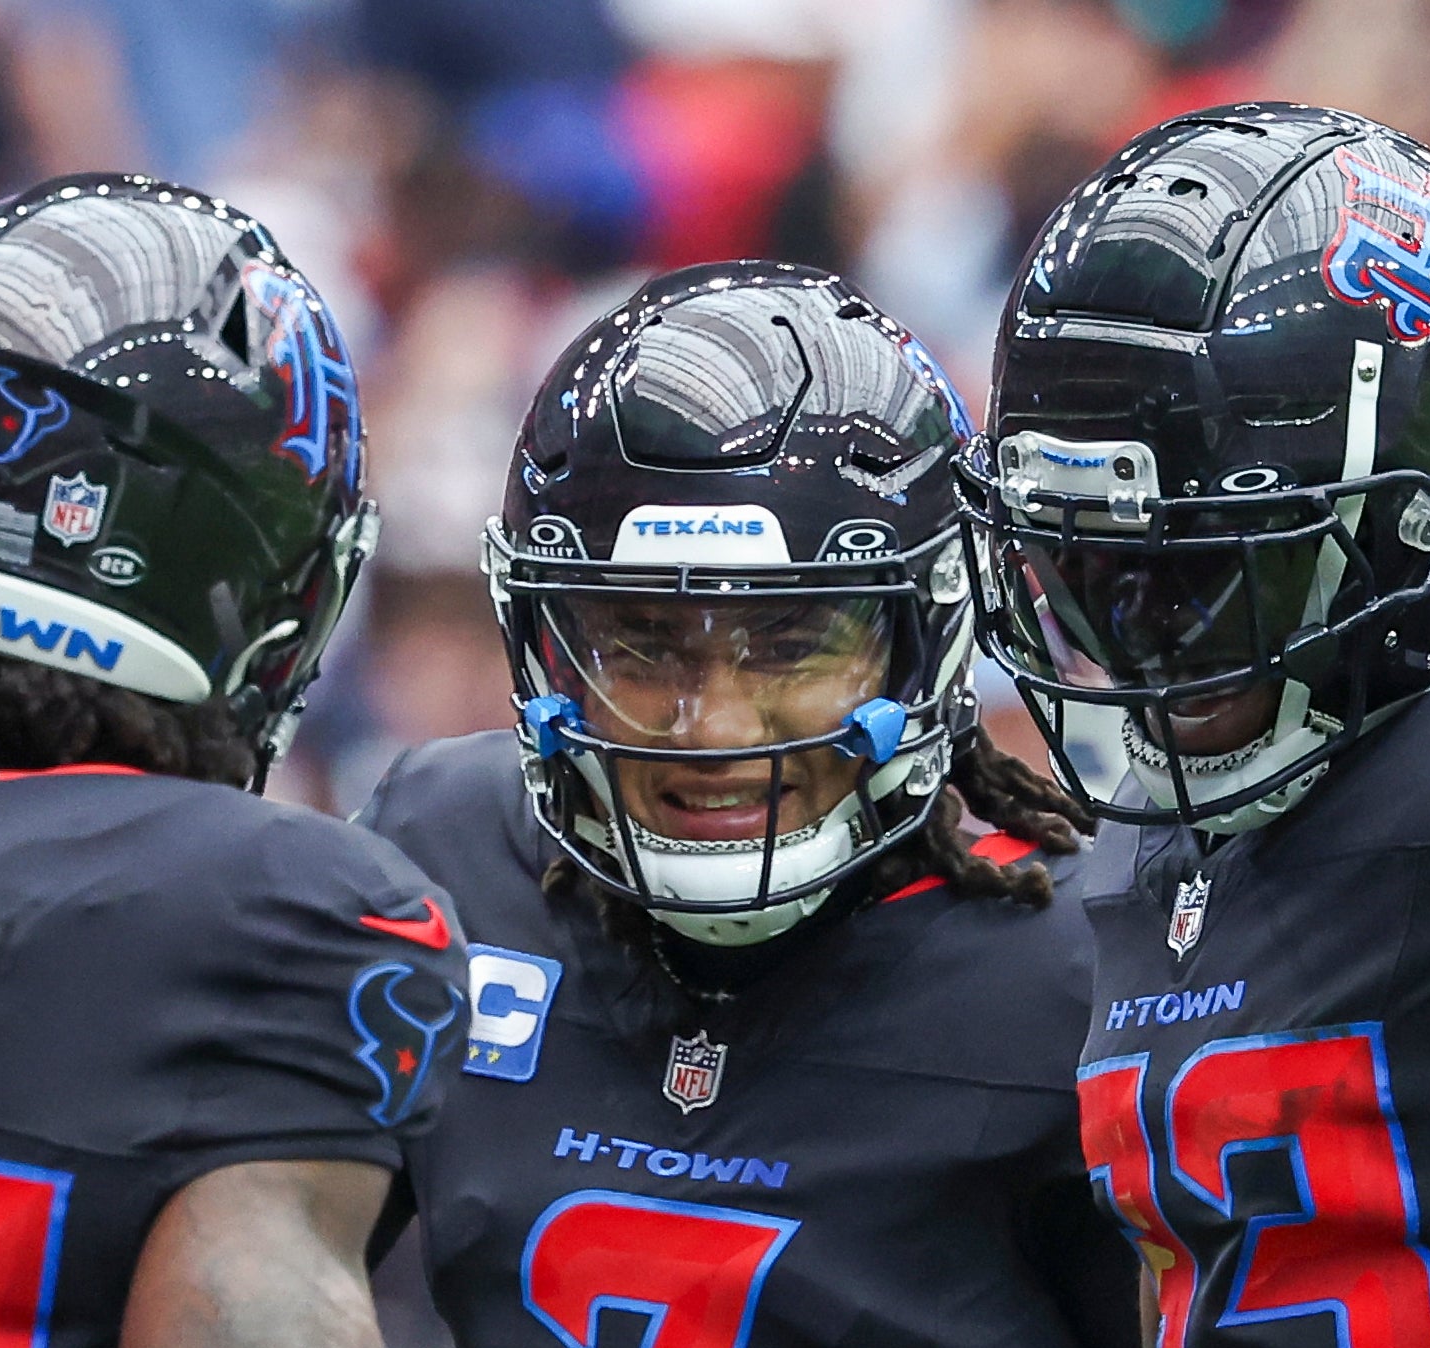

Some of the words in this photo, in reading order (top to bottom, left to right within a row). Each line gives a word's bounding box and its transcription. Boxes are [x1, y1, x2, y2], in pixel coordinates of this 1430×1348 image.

[52, 502, 92, 533] NFL
[632, 519, 765, 537] TEXANS
[468, 953, 548, 1048] C
[1105, 979, 1246, 1032] H-TOWN
[672, 1066, 709, 1098] NFL
[553, 1127, 790, 1188] H-TOWN
